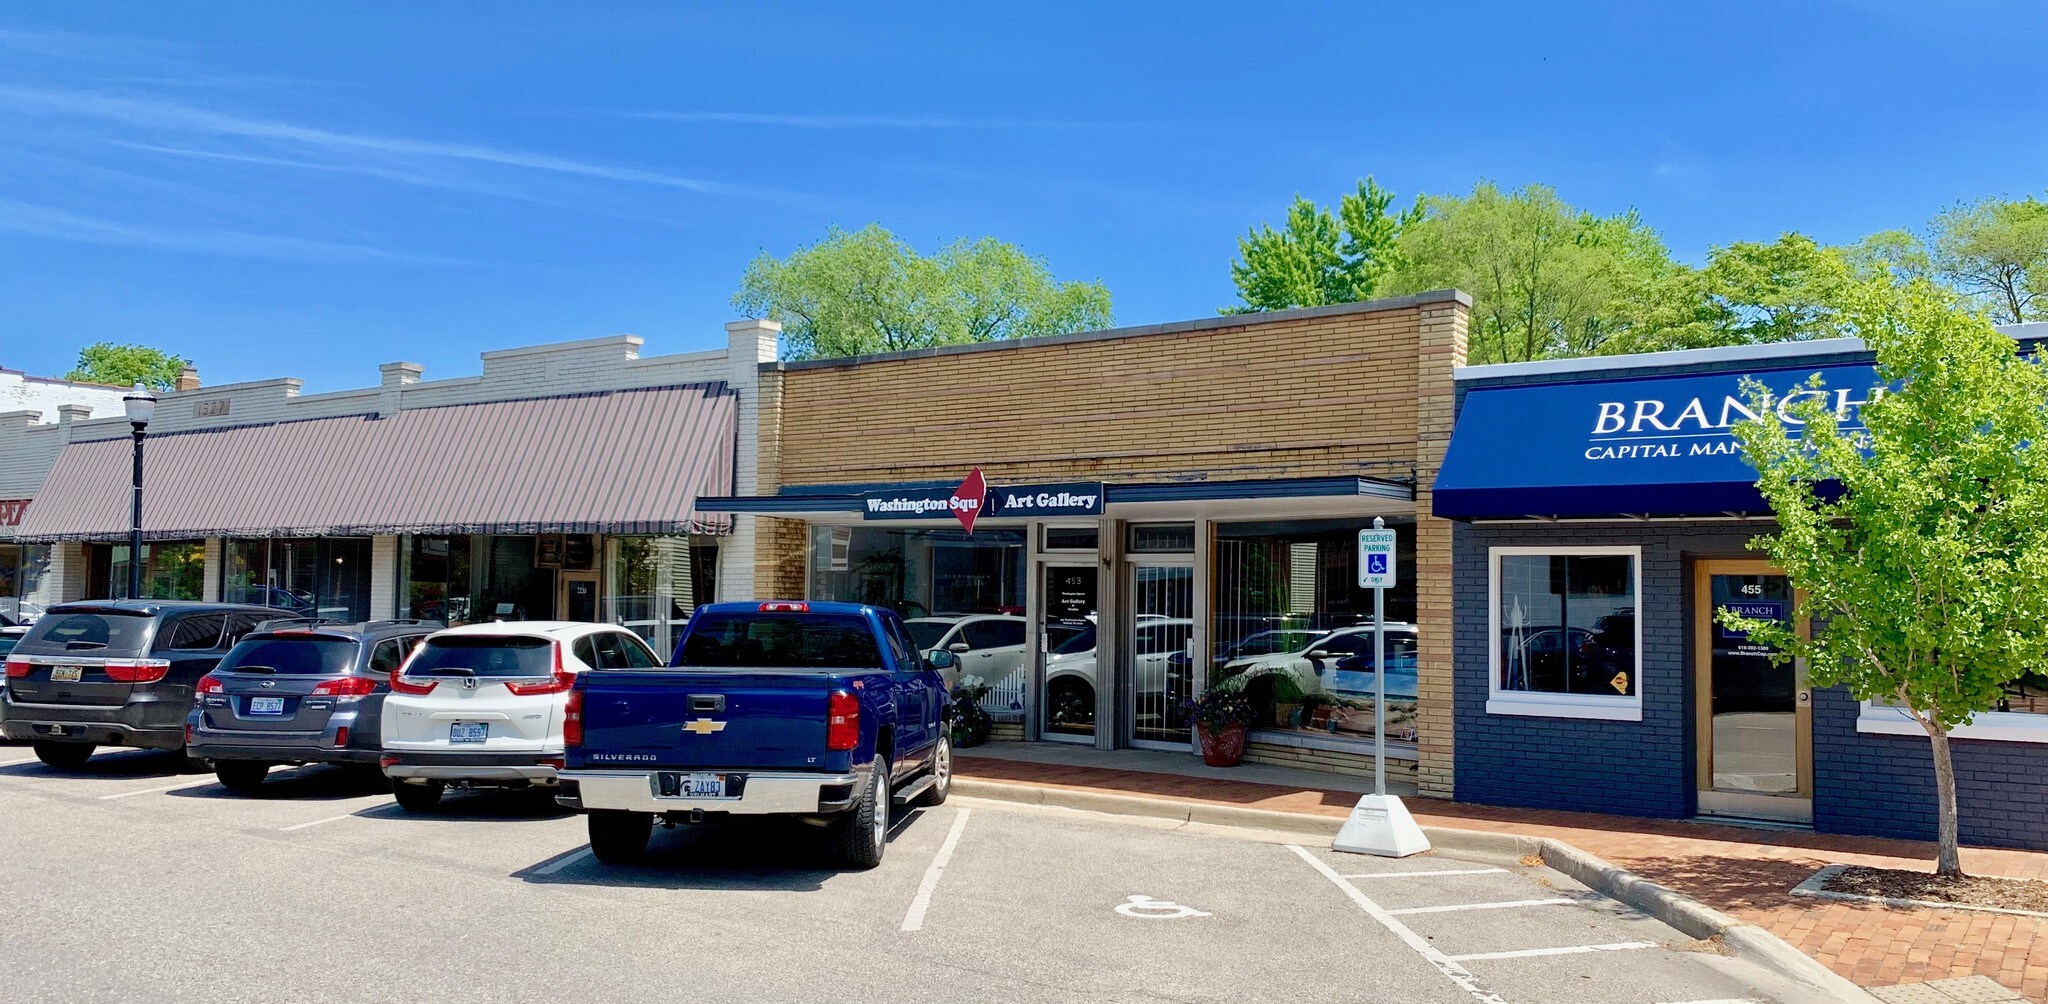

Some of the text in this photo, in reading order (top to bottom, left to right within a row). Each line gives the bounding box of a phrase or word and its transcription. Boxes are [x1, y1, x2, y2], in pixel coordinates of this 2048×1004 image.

[1591, 386, 1889, 434] BRANCH
[1584, 443, 1681, 460] CAPITAL
[1004, 492, 1097, 509] Art Gallery
[867, 497, 948, 514] Washington
[1361, 534, 1393, 542] RESERVED
[1364, 544, 1390, 552] PARKING
[1065, 576, 1082, 585] 453
[1741, 585, 1762, 595] 455
[1731, 606, 1773, 615] BRANCH
[592, 753, 657, 761] SILVERADO
